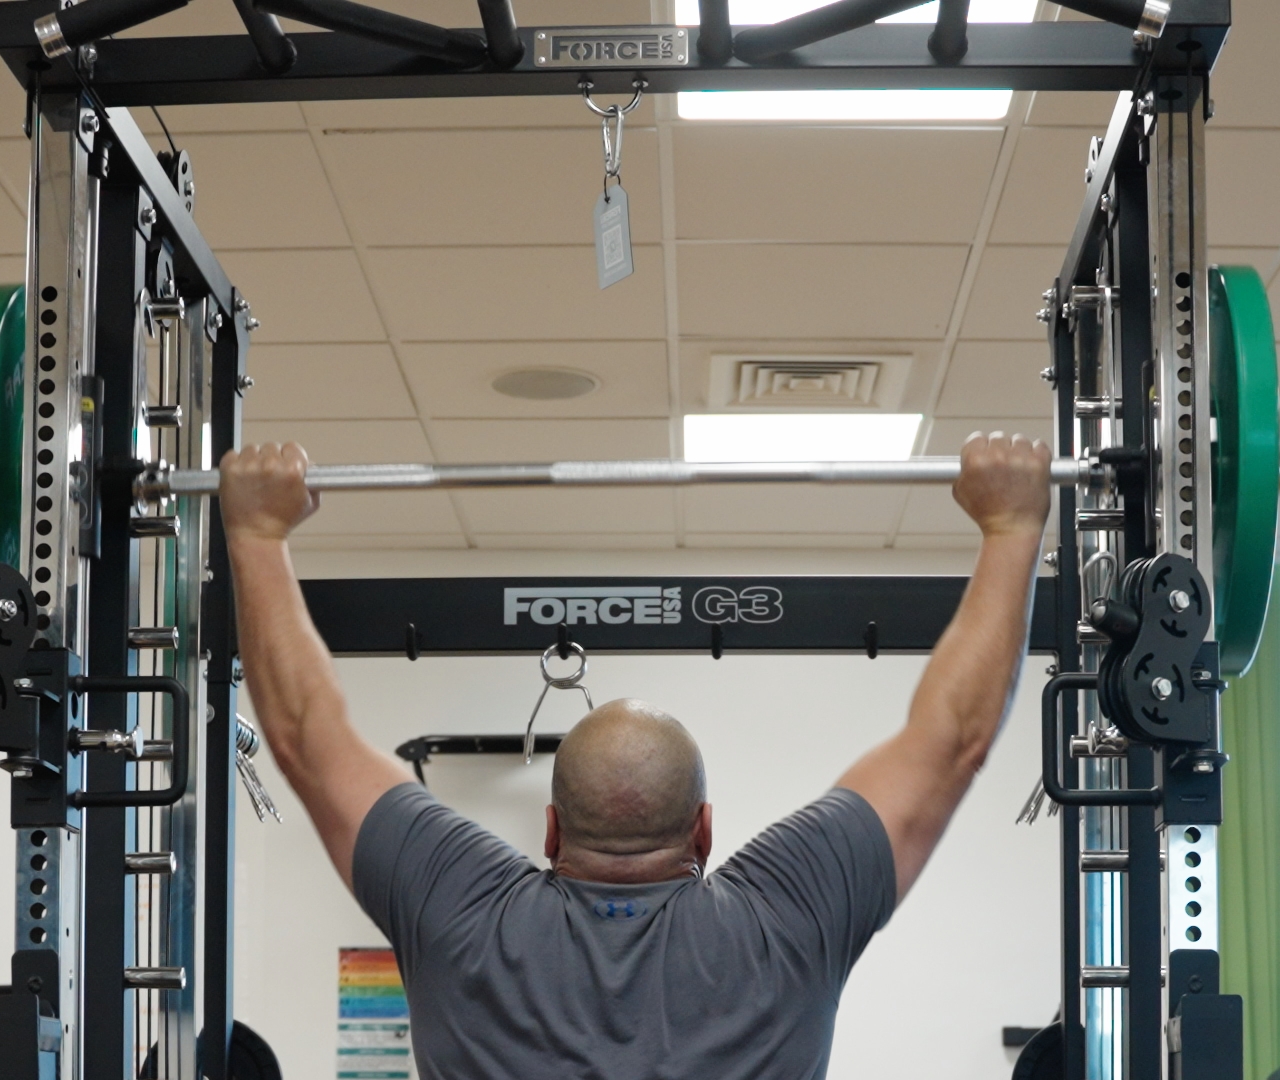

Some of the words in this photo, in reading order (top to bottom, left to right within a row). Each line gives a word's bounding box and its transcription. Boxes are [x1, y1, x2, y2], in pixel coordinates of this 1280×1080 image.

[551, 35, 659, 60] FORCE
[660, 34, 673, 59] USA
[503, 587, 662, 625] FORCE
[663, 586, 681, 625] USA
[692, 586, 783, 624] G3
